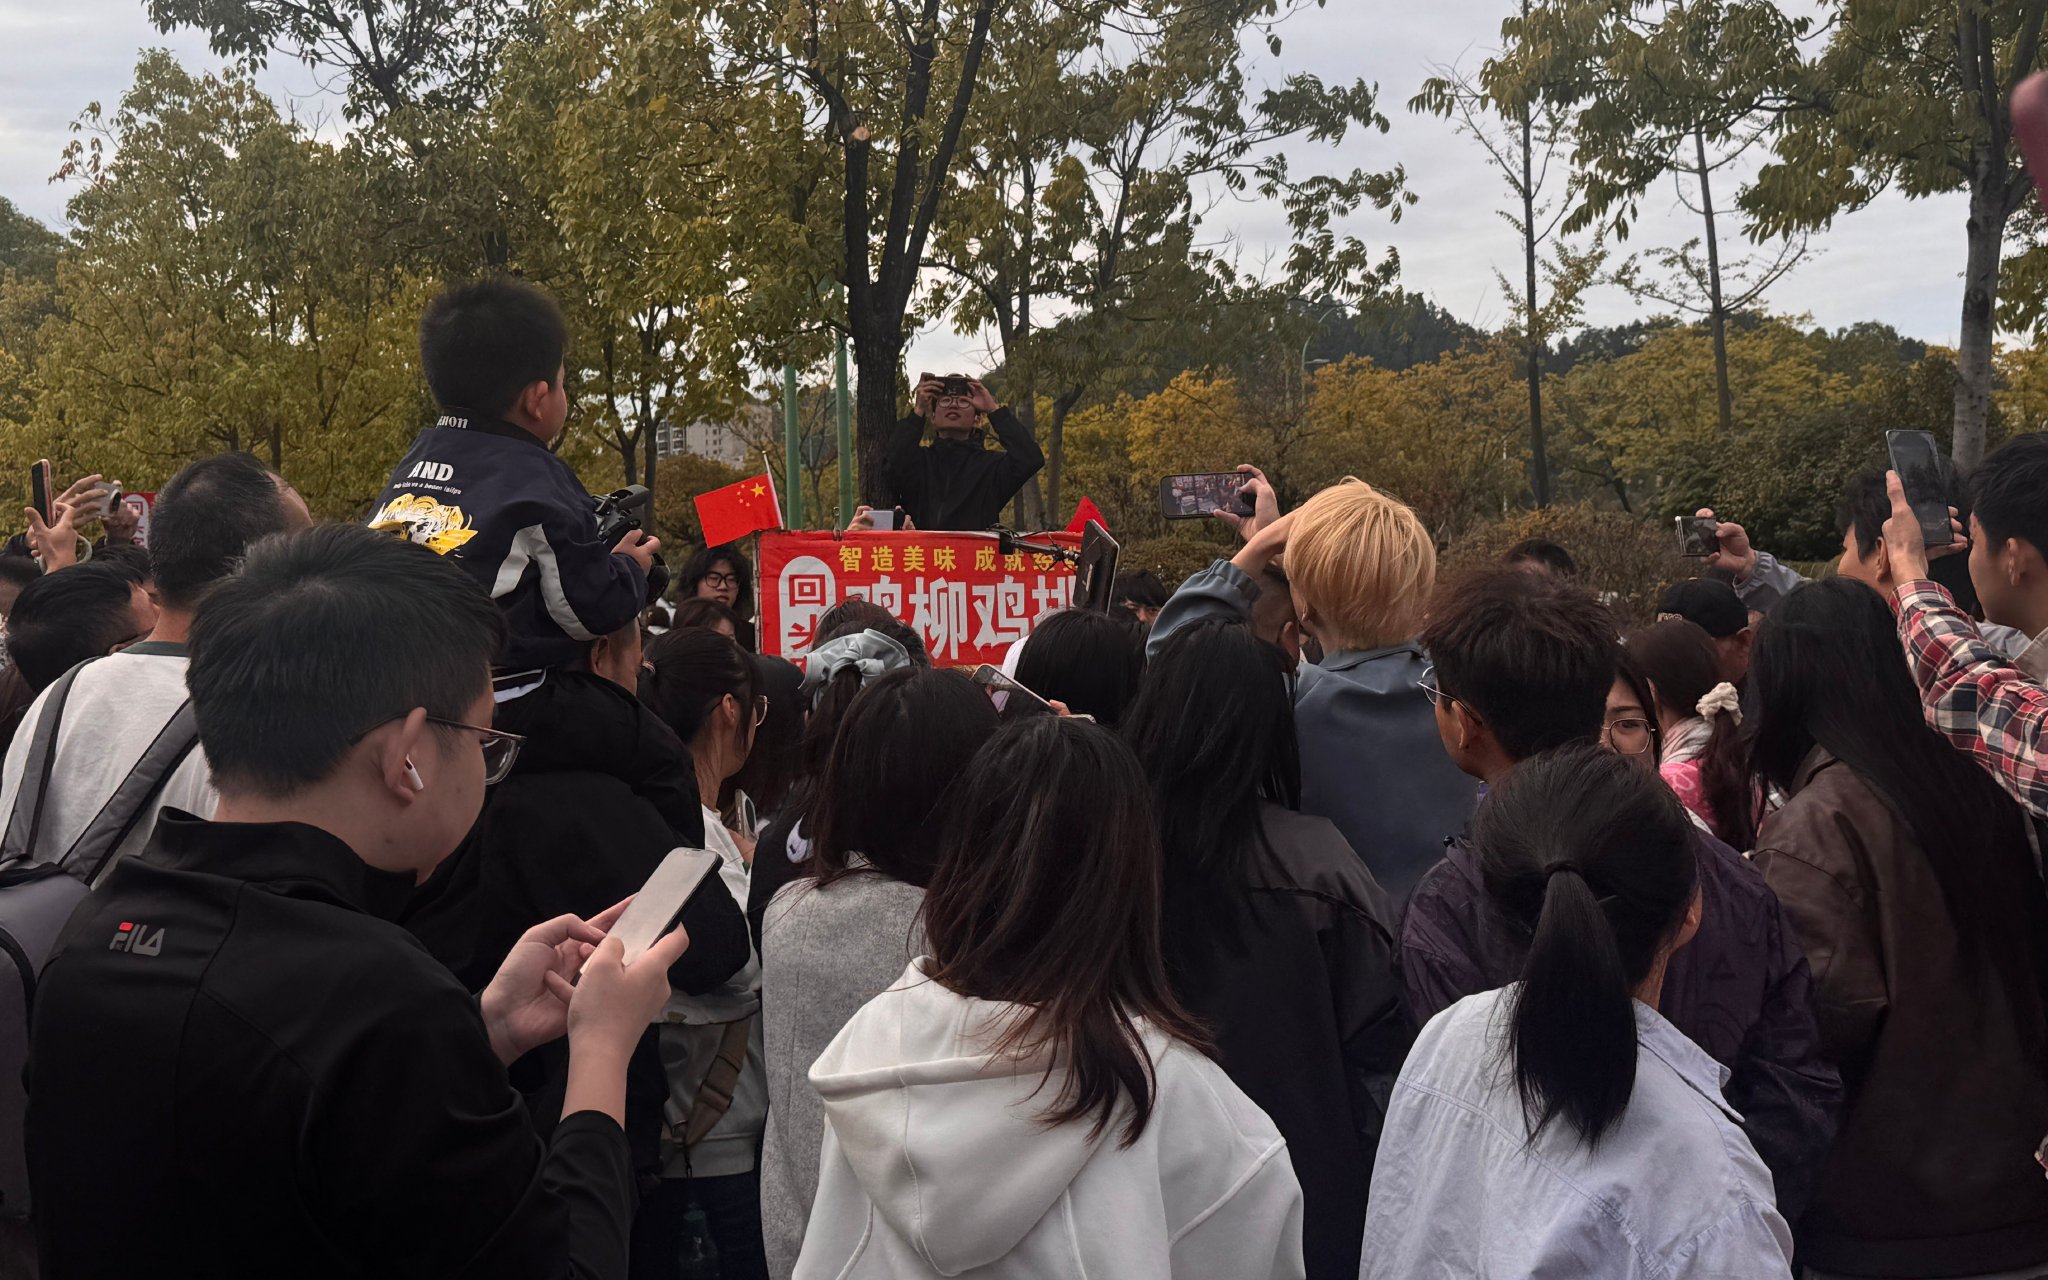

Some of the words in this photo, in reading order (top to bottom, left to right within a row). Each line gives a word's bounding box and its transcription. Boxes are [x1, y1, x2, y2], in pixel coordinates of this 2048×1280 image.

[407, 461, 454, 481] AND
[839, 545, 957, 573] 智造美味
[788, 574, 826, 670] 回头
[109, 922, 165, 957] FILA
